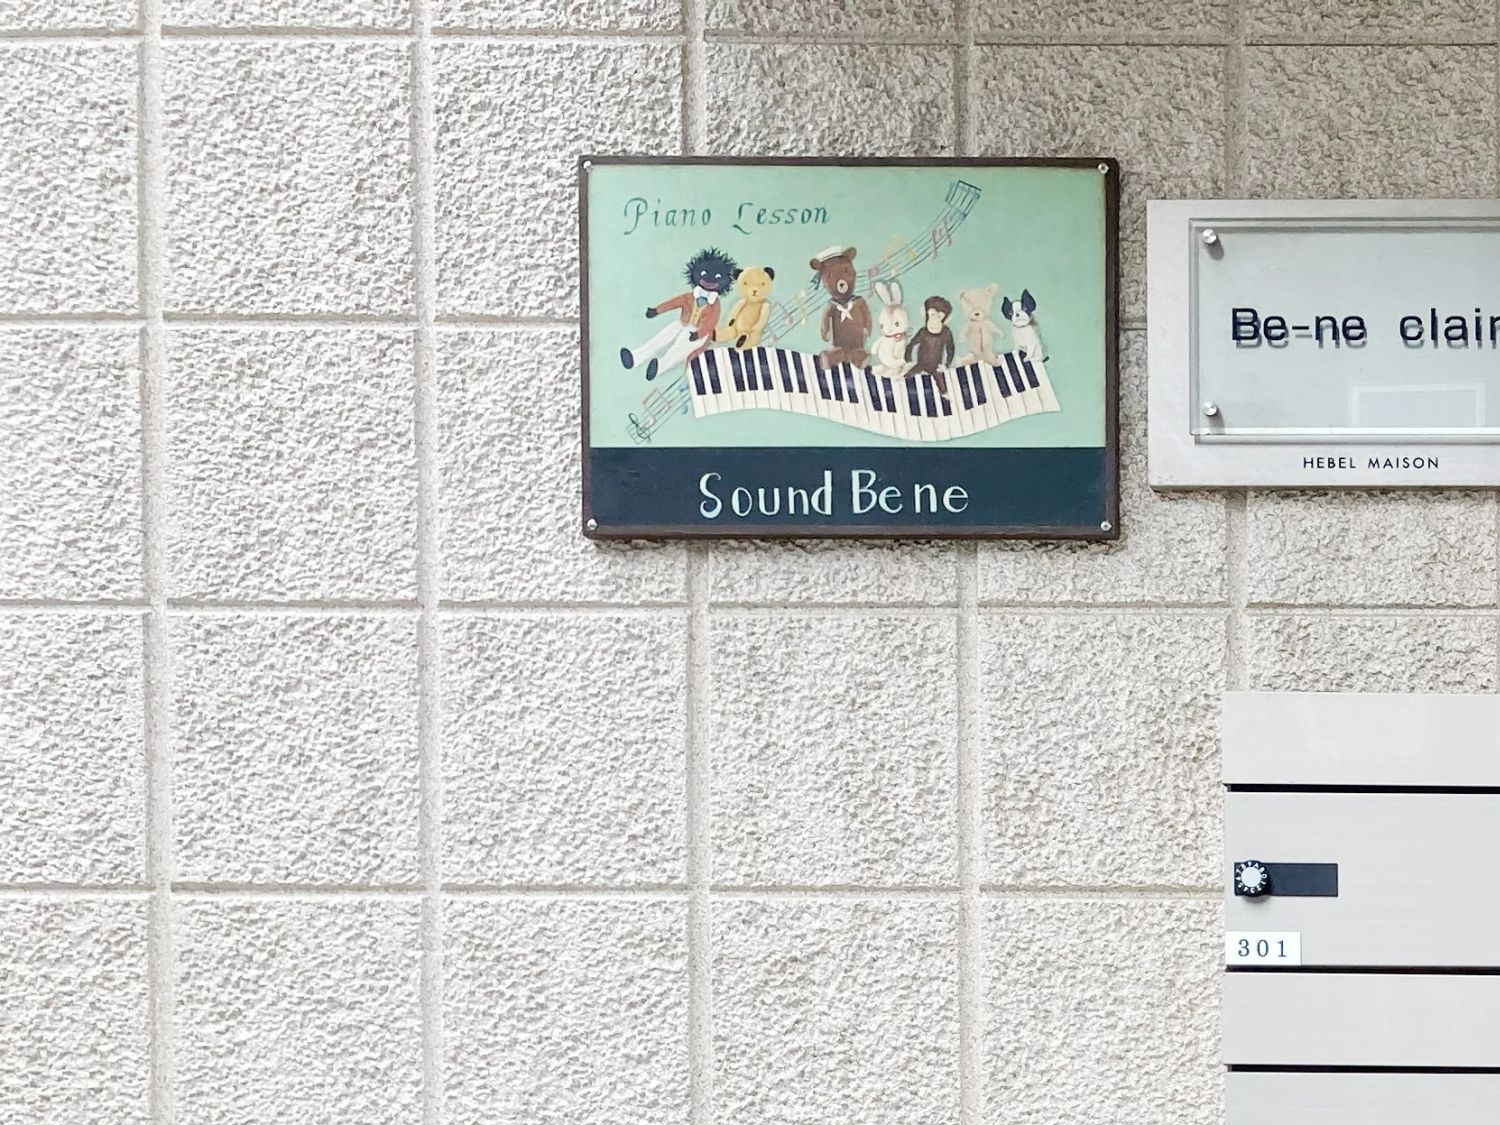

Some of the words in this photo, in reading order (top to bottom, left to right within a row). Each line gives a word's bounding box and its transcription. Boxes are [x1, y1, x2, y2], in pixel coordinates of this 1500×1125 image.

[623, 197, 712, 235] Piano
[731, 201, 830, 234] Lesson
[1231, 307, 1366, 341] Be-ne
[1302, 456, 1357, 469] HEBEL
[1367, 456, 1440, 470] MAISON
[699, 470, 833, 518] Sound
[1237, 939, 1288, 958] 301
